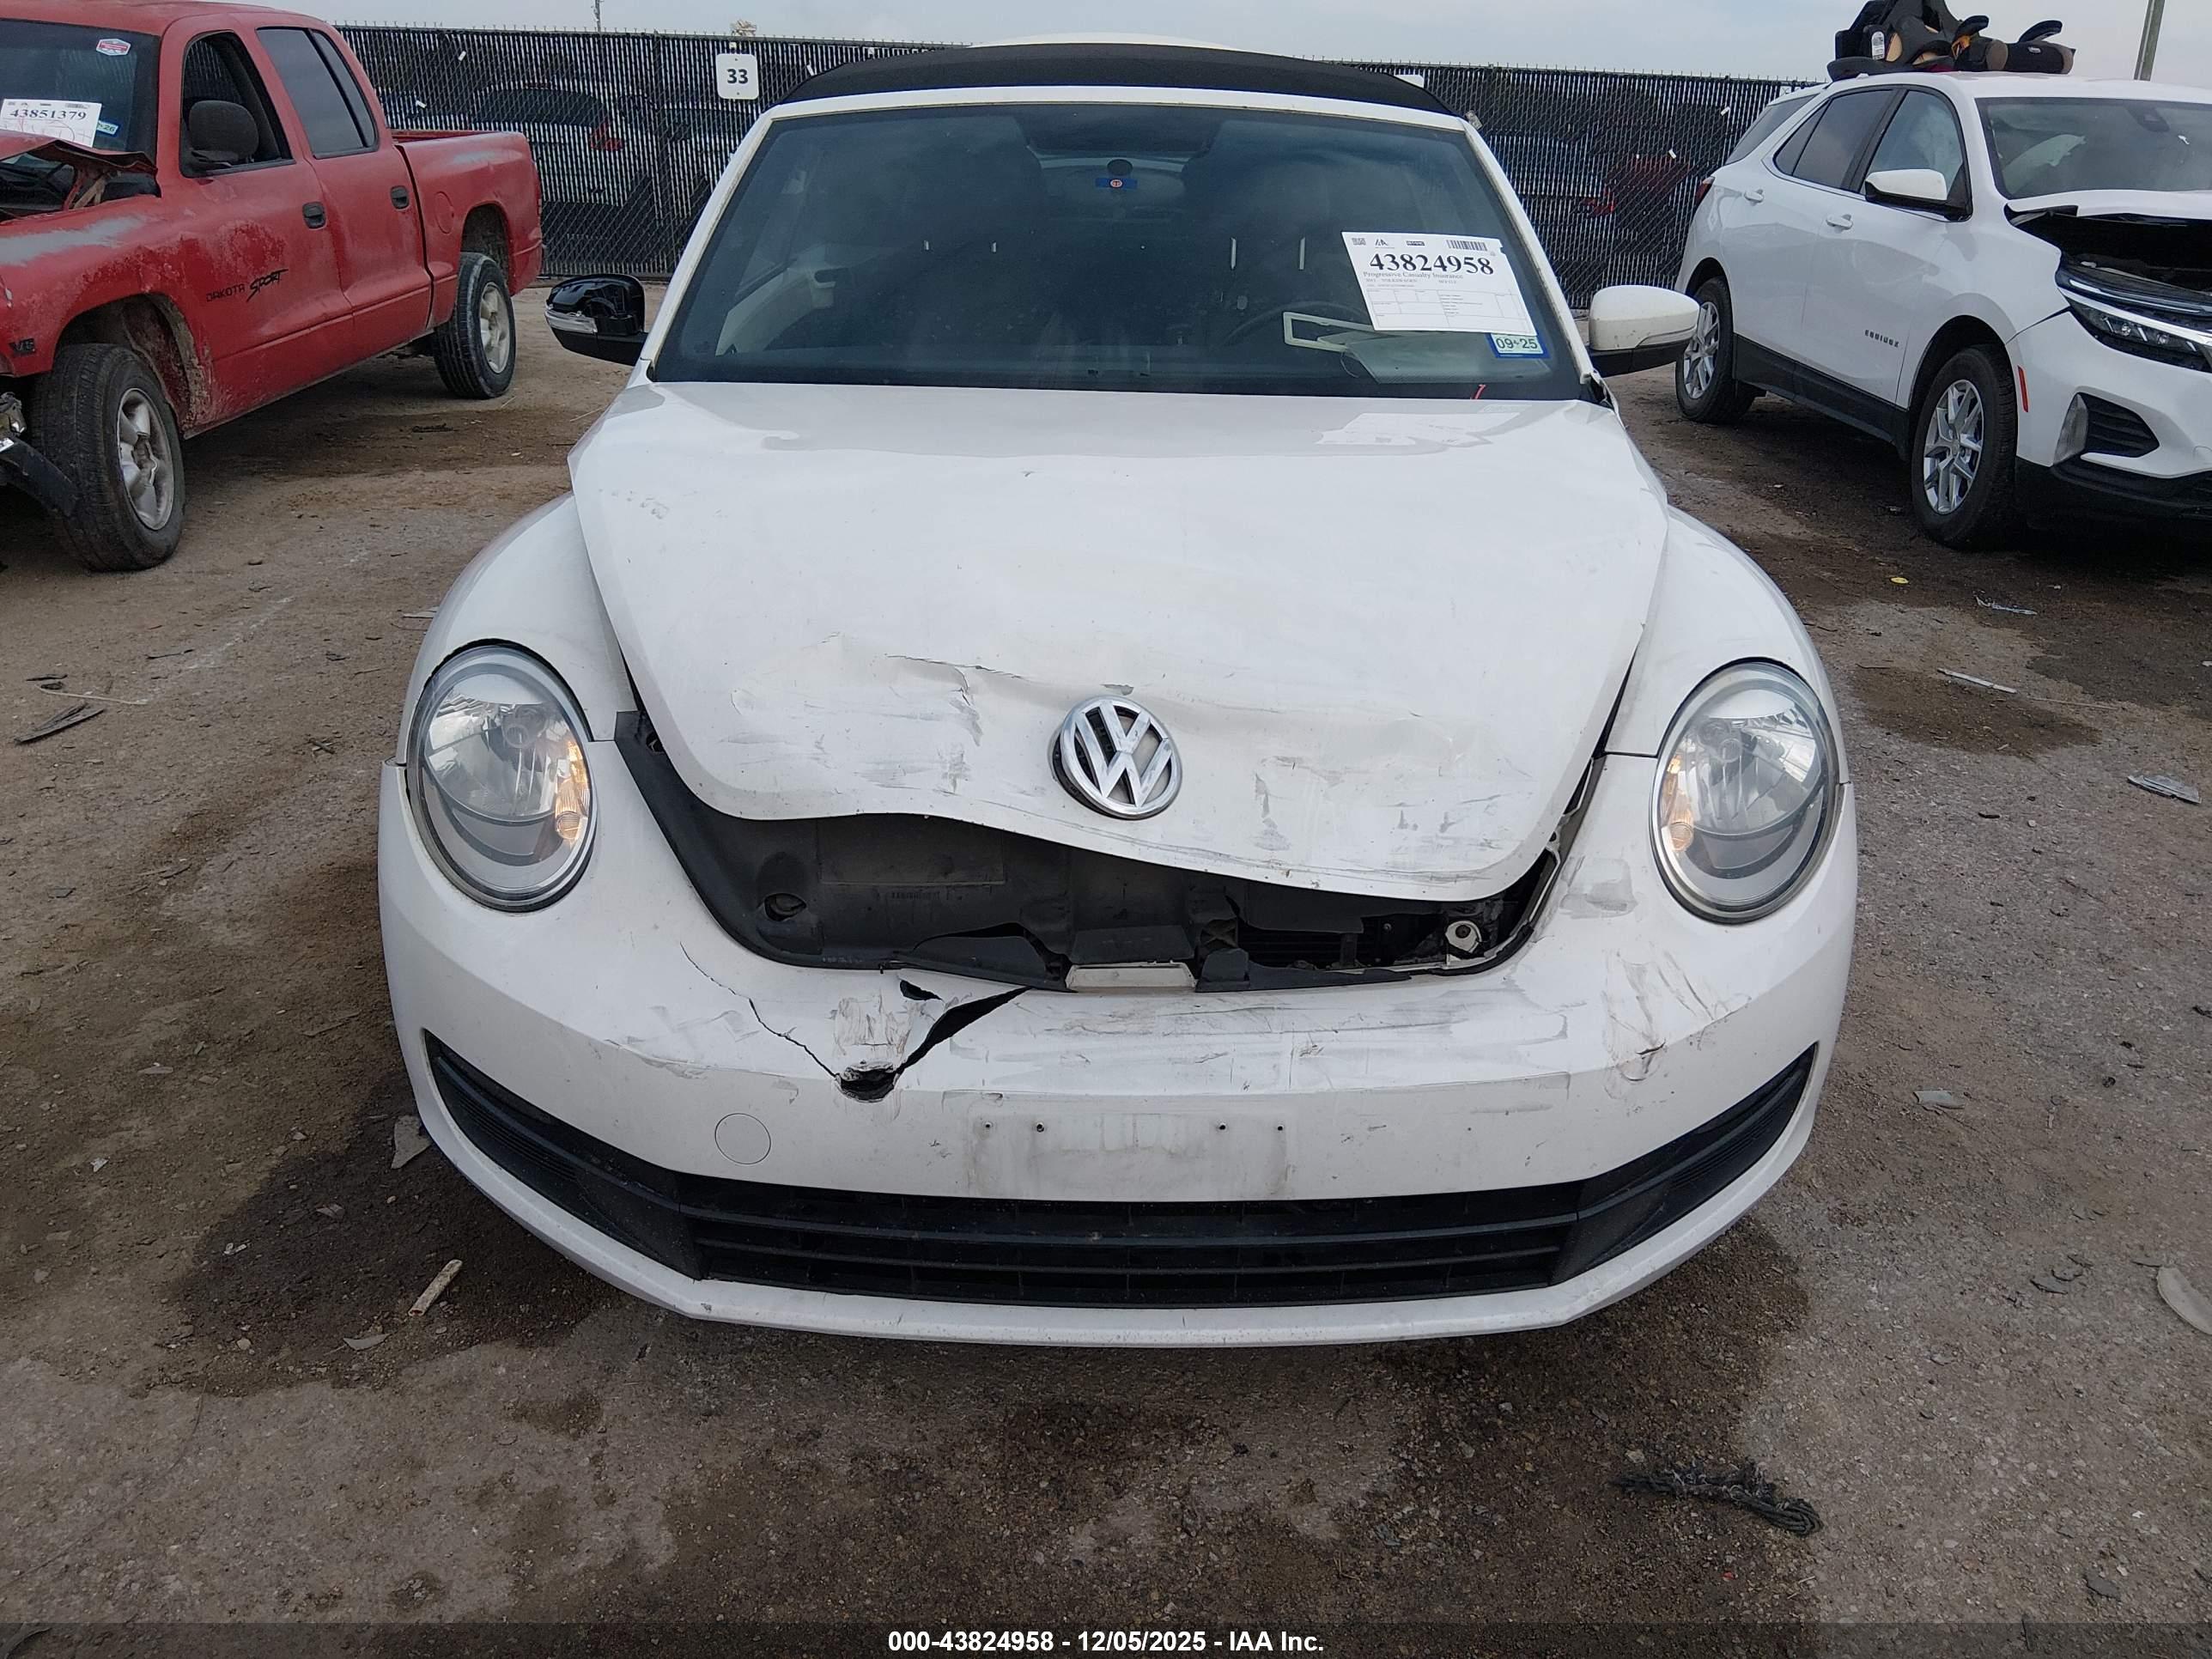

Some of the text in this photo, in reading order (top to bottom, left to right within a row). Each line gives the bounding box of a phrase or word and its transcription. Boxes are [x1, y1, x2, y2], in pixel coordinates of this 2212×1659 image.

[726, 68, 749, 84] 33
[10, 109, 87, 120] 43851379
[1370, 253, 1494, 275] 43824958
[206, 269, 289, 302] DAKOTA SPORT
[1496, 338, 1539, 349] 09 25
[1864, 329, 1899, 348] EQUINOX
